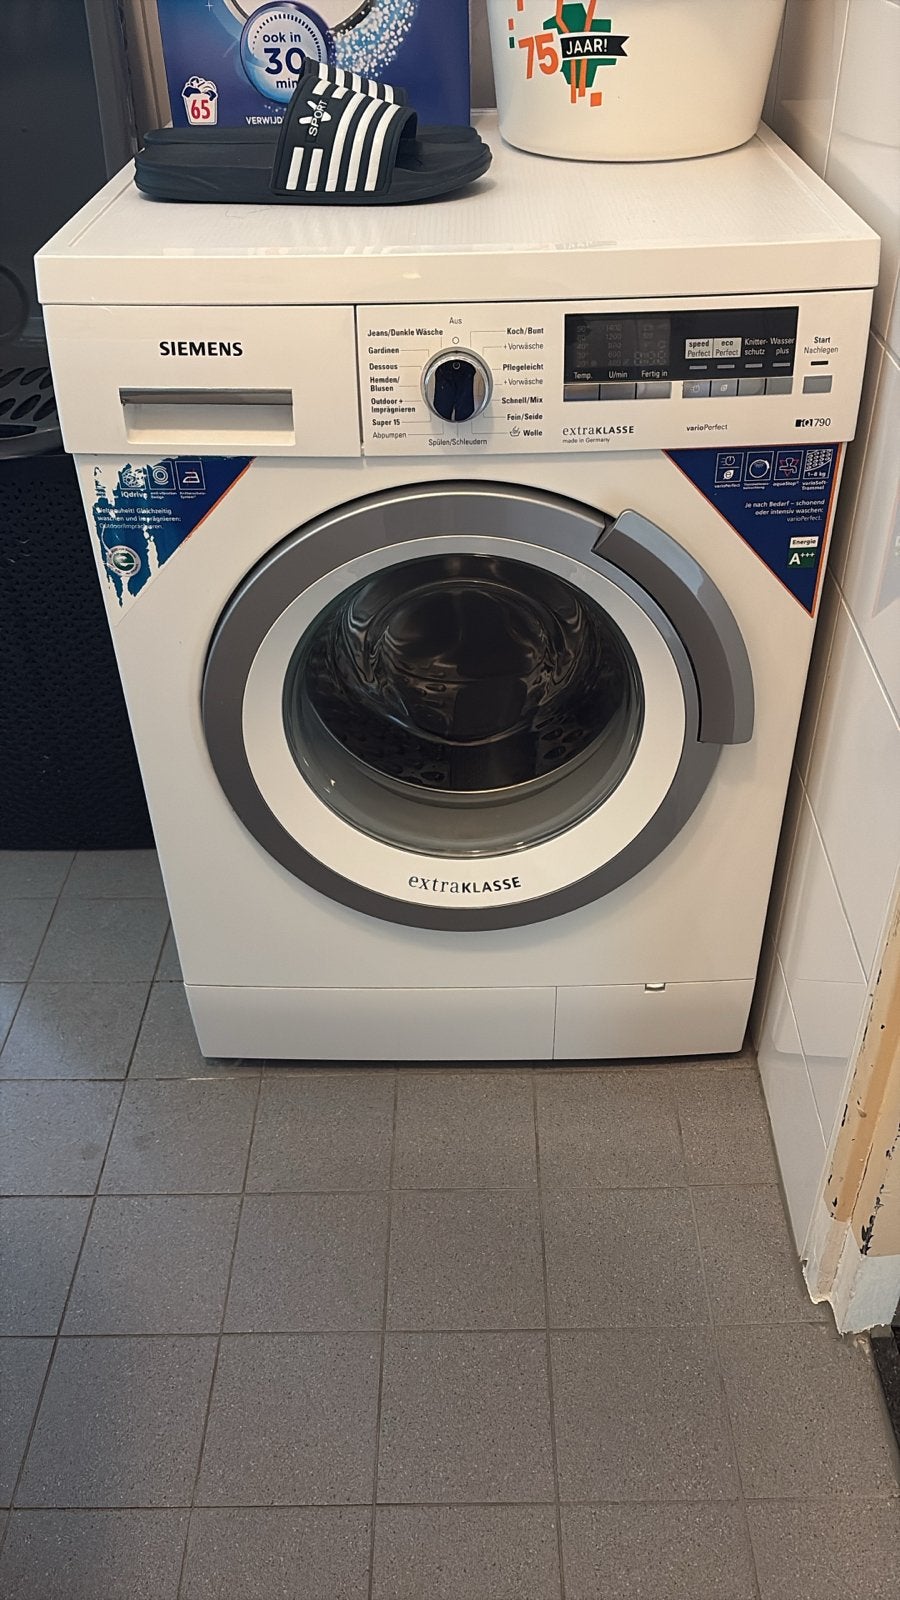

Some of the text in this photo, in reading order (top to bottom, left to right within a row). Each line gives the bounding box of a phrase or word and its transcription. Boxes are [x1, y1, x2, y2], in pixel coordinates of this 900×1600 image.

[262, 31, 301, 43] ook in
[565, 38, 608, 55] JAAR!
[518, 32, 559, 79] 75
[263, 47, 306, 75] 30
[190, 99, 211, 120] 65
[245, 116, 285, 126] VERWIJD
[308, 100, 328, 137] SPORT
[449, 316, 463, 325] Aus
[367, 327, 444, 338] Jeans/Dunkle Wäsche
[506, 326, 545, 335] Koch/Bunt
[688, 340, 710, 348] speed
[744, 337, 769, 347] Knitter-
[770, 336, 795, 346] Wasser
[814, 335, 831, 344] Start
[159, 341, 243, 357] SIEMENS
[368, 346, 400, 355] Gardinen
[687, 348, 711, 358] Perfect
[715, 347, 739, 357] Perfect
[744, 347, 766, 356] schutz
[775, 347, 790, 356] plus
[803, 345, 839, 355] Nachlegen
[369, 362, 398, 371] Dessous
[502, 363, 544, 373] Pflegeleicht
[573, 371, 593, 380] Temp.
[608, 370, 628, 379] U/min
[641, 369, 669, 379] Fertig in
[369, 375, 400, 384] Hemden/
[370, 385, 394, 393] Blusen
[371, 397, 398, 406] Outdoor
[501, 396, 543, 405] Schnell/Mix
[371, 405, 417, 415] Imprägnieren
[507, 413, 543, 422] Fein/Seide
[372, 418, 401, 428] Super 15
[686, 424, 728, 432] varioPerfect
[523, 429, 543, 438] Wolle
[562, 425, 635, 436] extraKLASSE
[372, 431, 407, 441] Abpumpen
[585, 436, 610, 444] Germany
[428, 438, 488, 448] Spülen/Schleudern
[769, 500, 790, 508] Bedarf
[796, 499, 826, 507] schonend
[770, 507, 795, 515] intensiv
[408, 875, 522, 894] extraKLASSE
